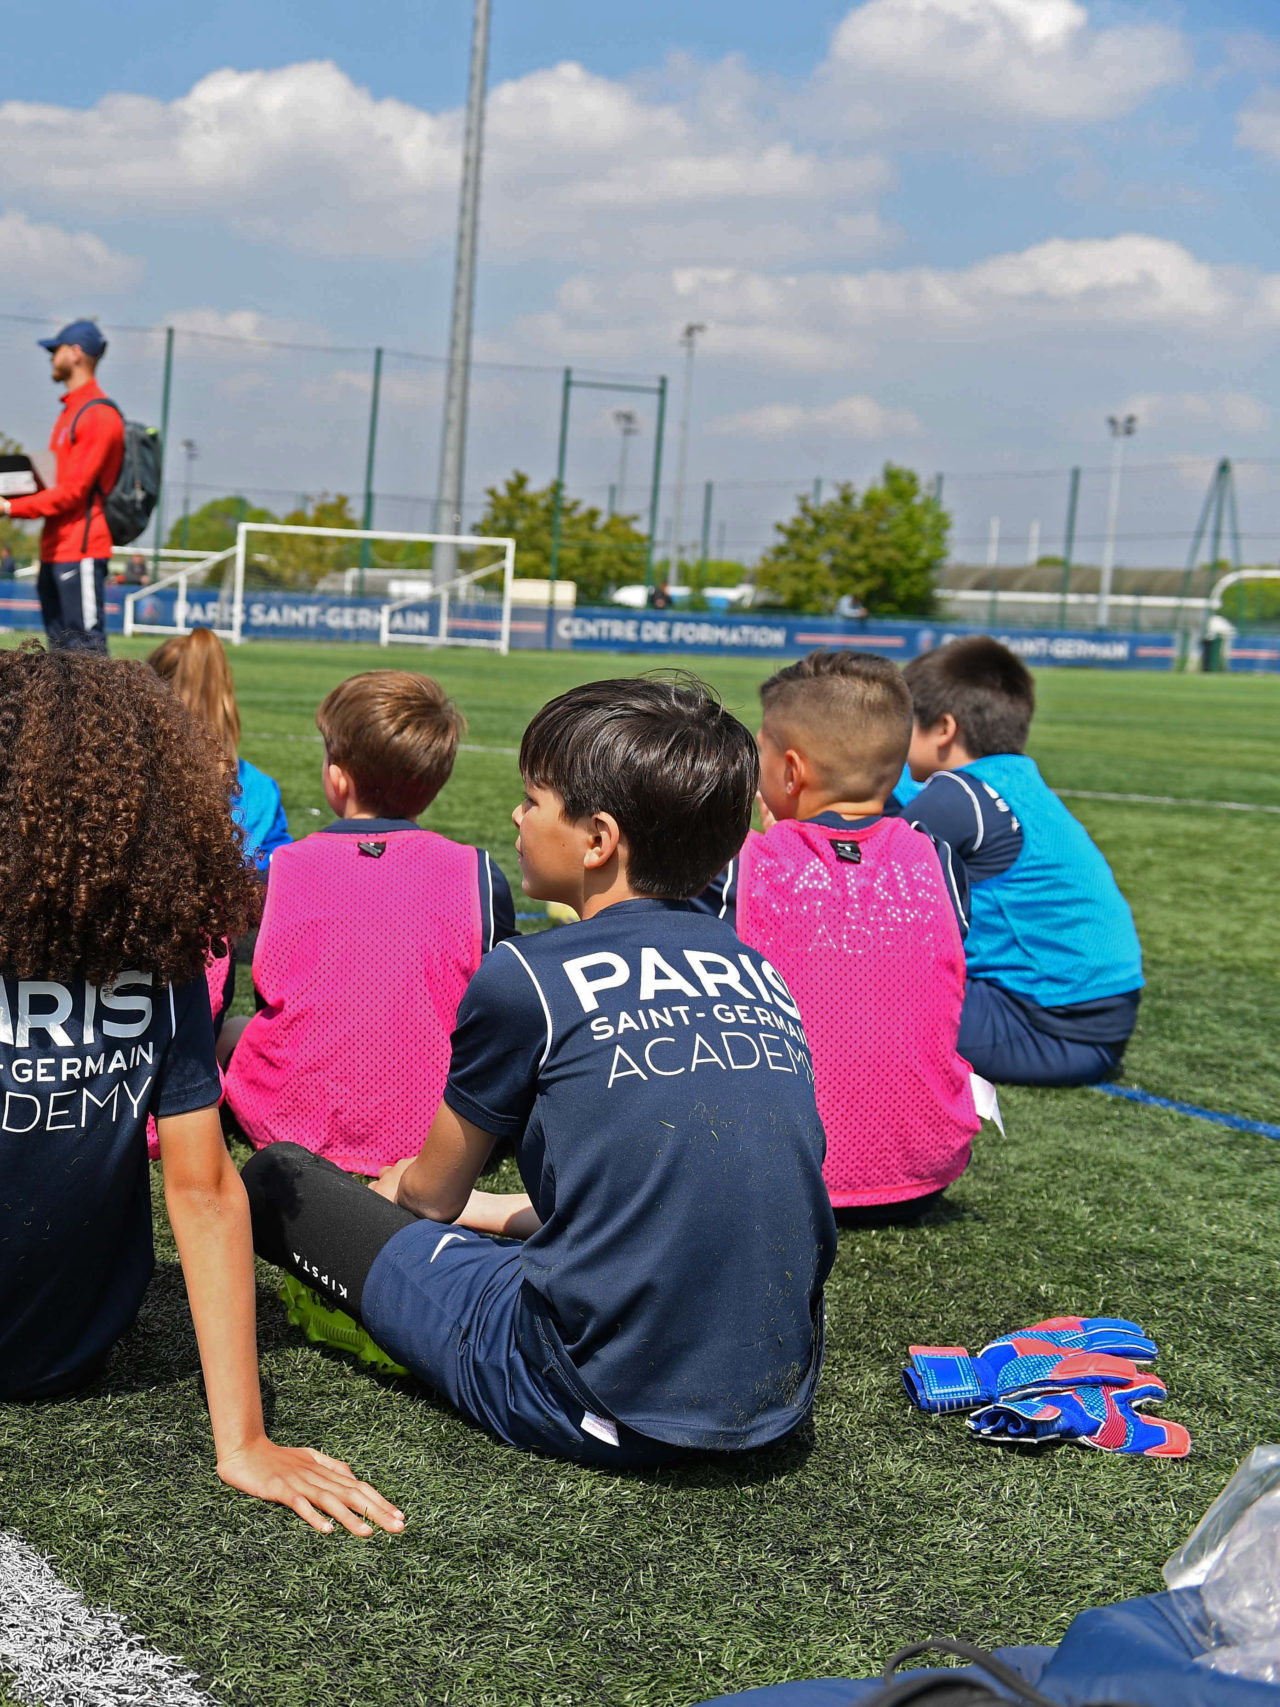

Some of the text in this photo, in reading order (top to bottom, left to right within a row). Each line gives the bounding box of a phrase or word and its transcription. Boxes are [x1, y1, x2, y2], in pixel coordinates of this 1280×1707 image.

[557, 617, 787, 647] CENTRE DE FORMATION
[562, 947, 802, 1020] PARIS
[293, 1252, 347, 1298] KIPSTA
